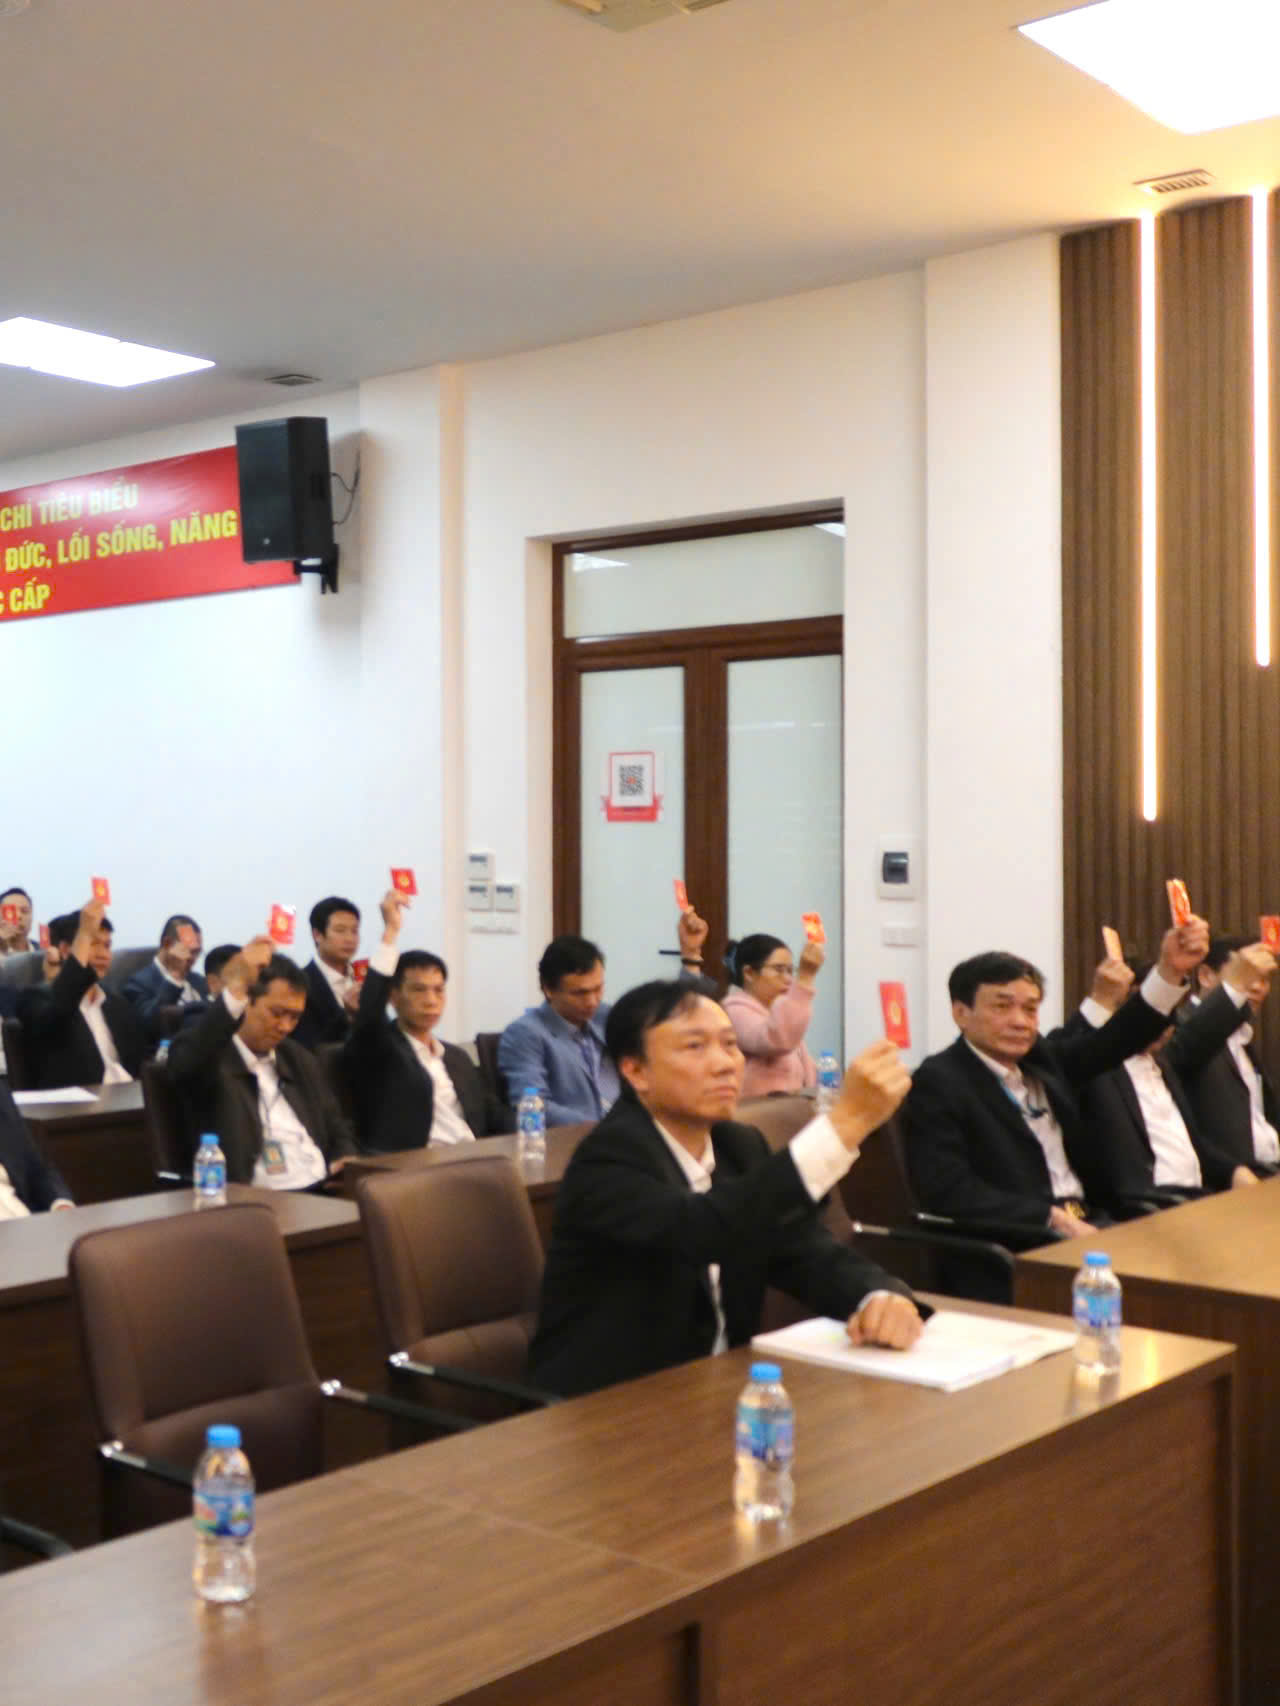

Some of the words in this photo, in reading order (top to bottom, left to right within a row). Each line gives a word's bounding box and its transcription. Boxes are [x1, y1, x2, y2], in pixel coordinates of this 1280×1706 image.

[0, 502, 32, 531] CHÍ
[38, 493, 83, 524] TIÊU
[89, 477, 139, 515] BIỂU
[58, 527, 90, 564] LỐI
[96, 520, 164, 558] SỐNG,
[170, 510, 238, 546] NĂNG
[9, 577, 51, 612] CẤP
